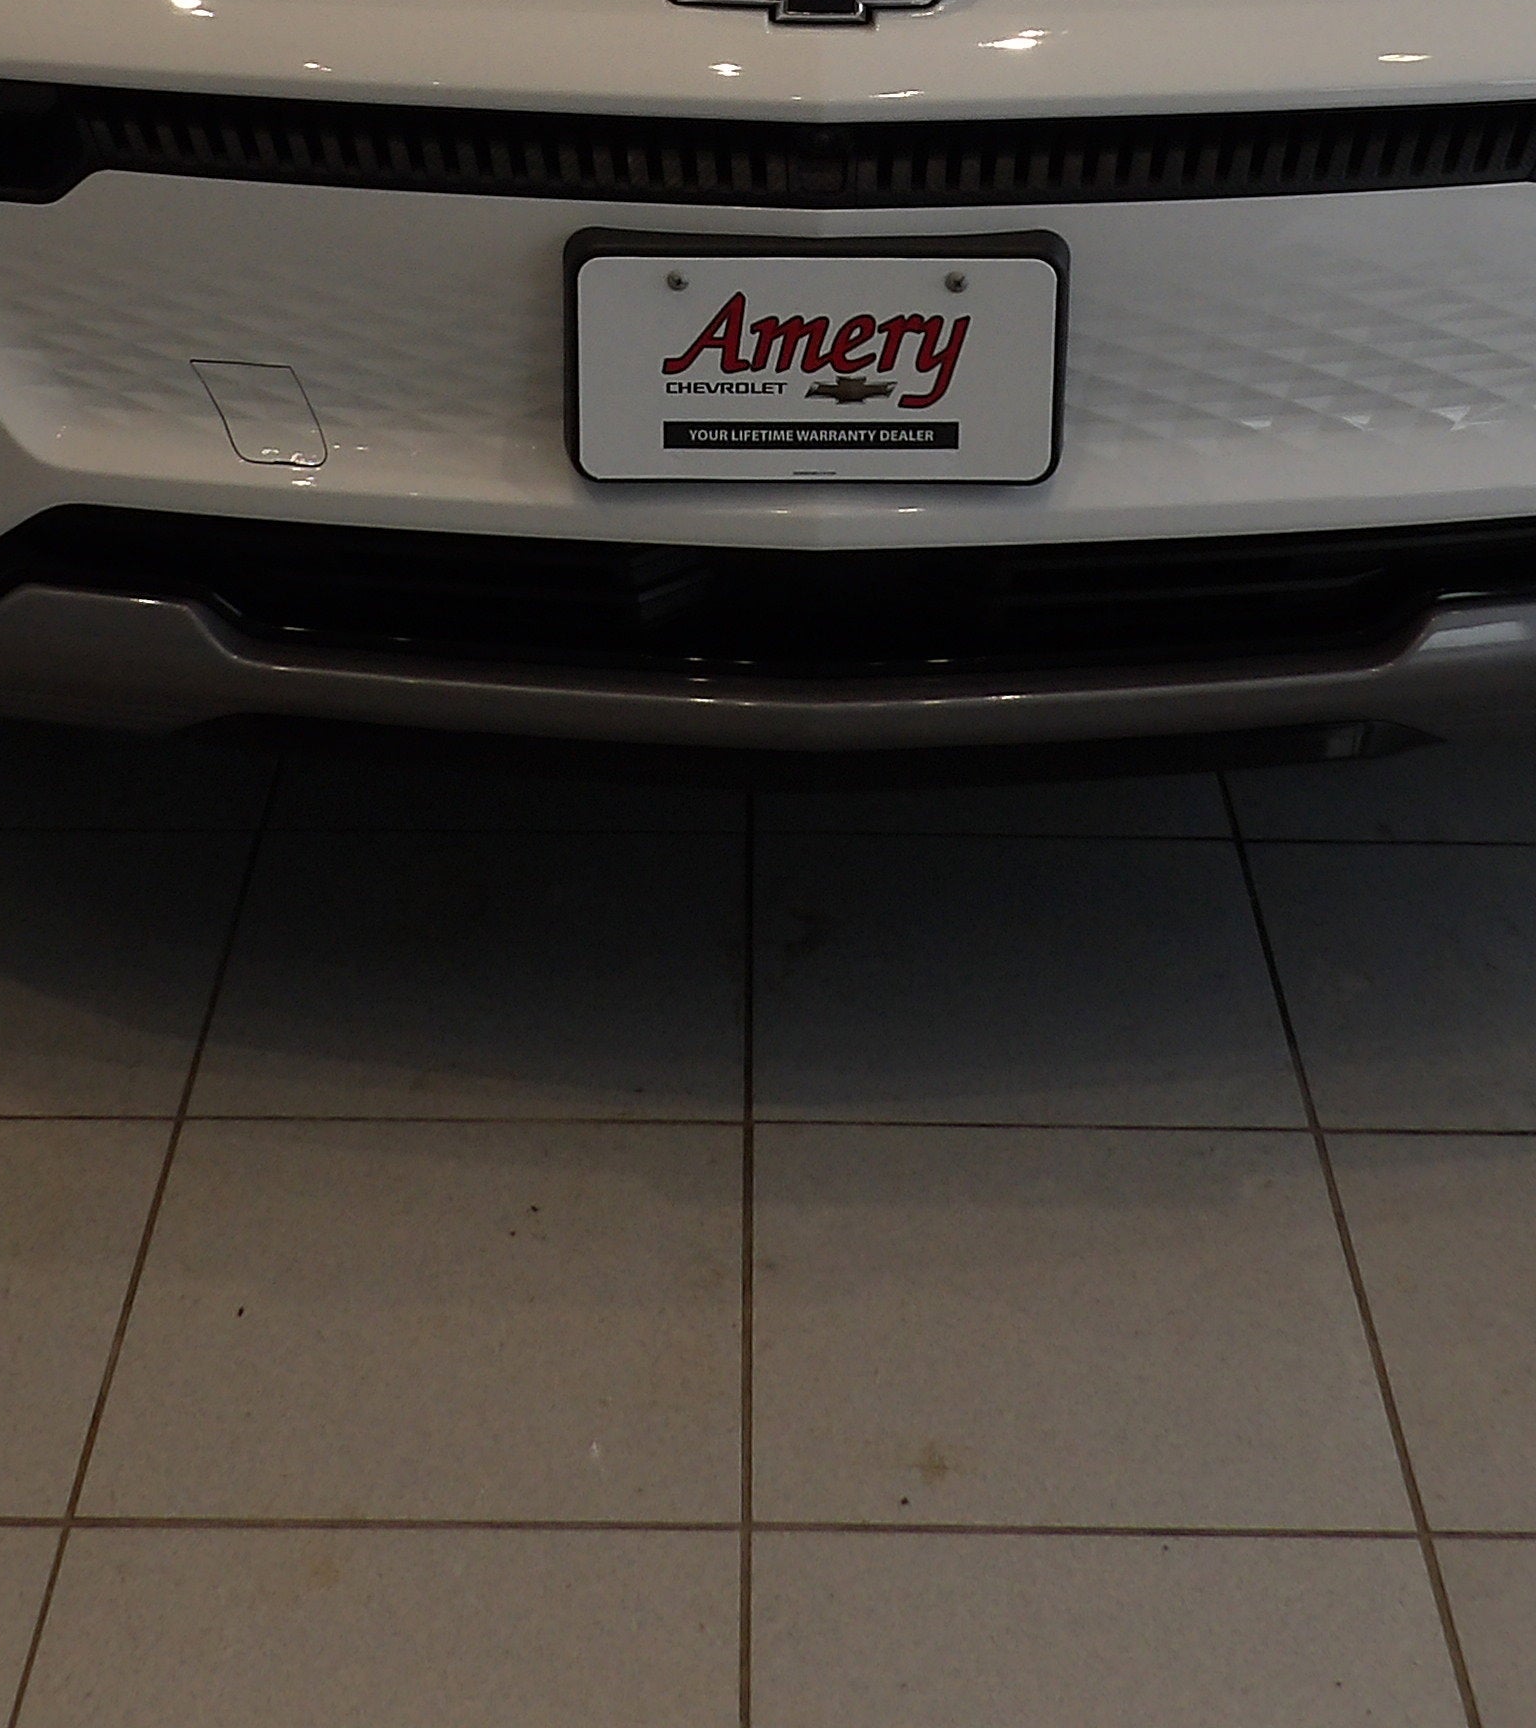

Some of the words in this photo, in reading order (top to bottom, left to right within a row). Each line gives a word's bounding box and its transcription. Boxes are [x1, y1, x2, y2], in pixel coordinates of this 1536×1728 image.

[662, 291, 971, 409] Amery
[666, 382, 788, 395] CHEVROLET
[689, 429, 728, 442] YOUR
[731, 429, 794, 442] LIFETIME
[796, 429, 877, 442] WARRANTY
[879, 429, 935, 442] DEALER
